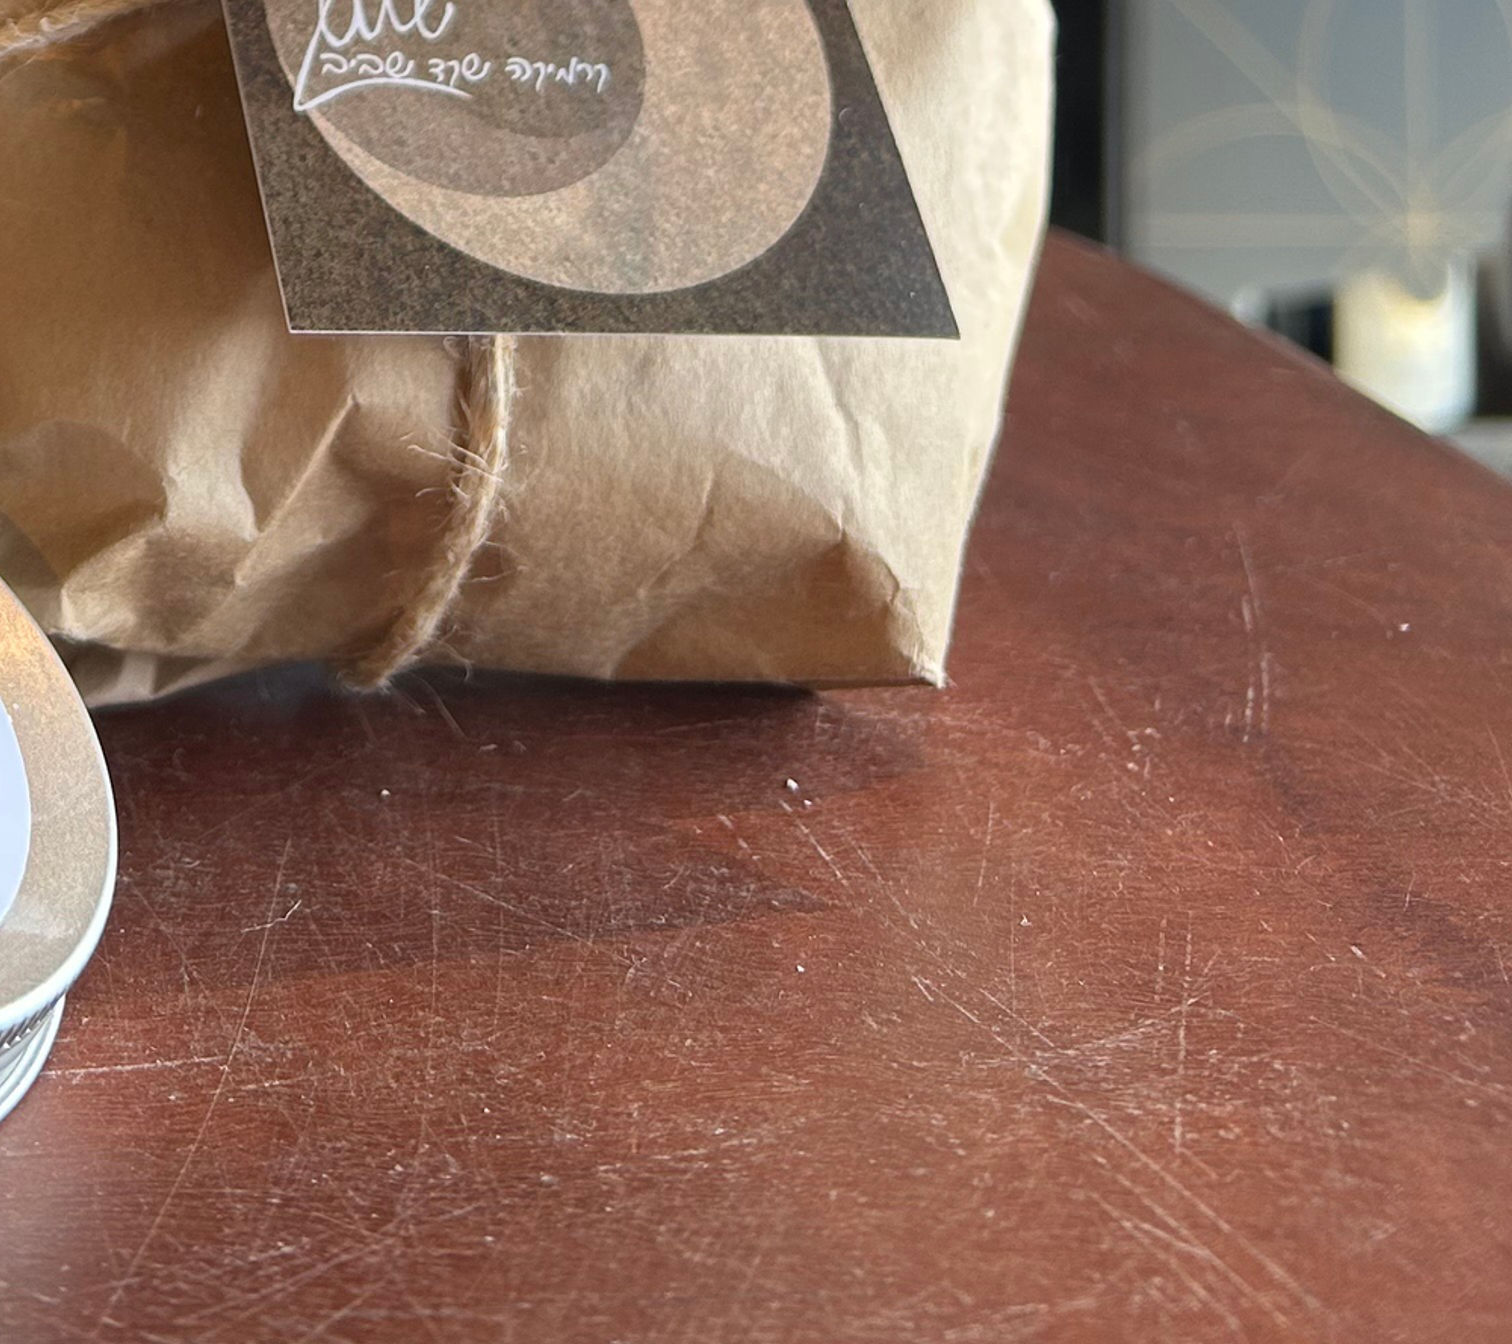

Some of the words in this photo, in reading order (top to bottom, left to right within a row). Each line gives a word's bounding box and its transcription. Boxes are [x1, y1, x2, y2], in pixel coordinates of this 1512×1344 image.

[319, 50, 415, 80] שביב
[426, 52, 492, 86] שקד
[504, 55, 611, 94] קרמיקה
